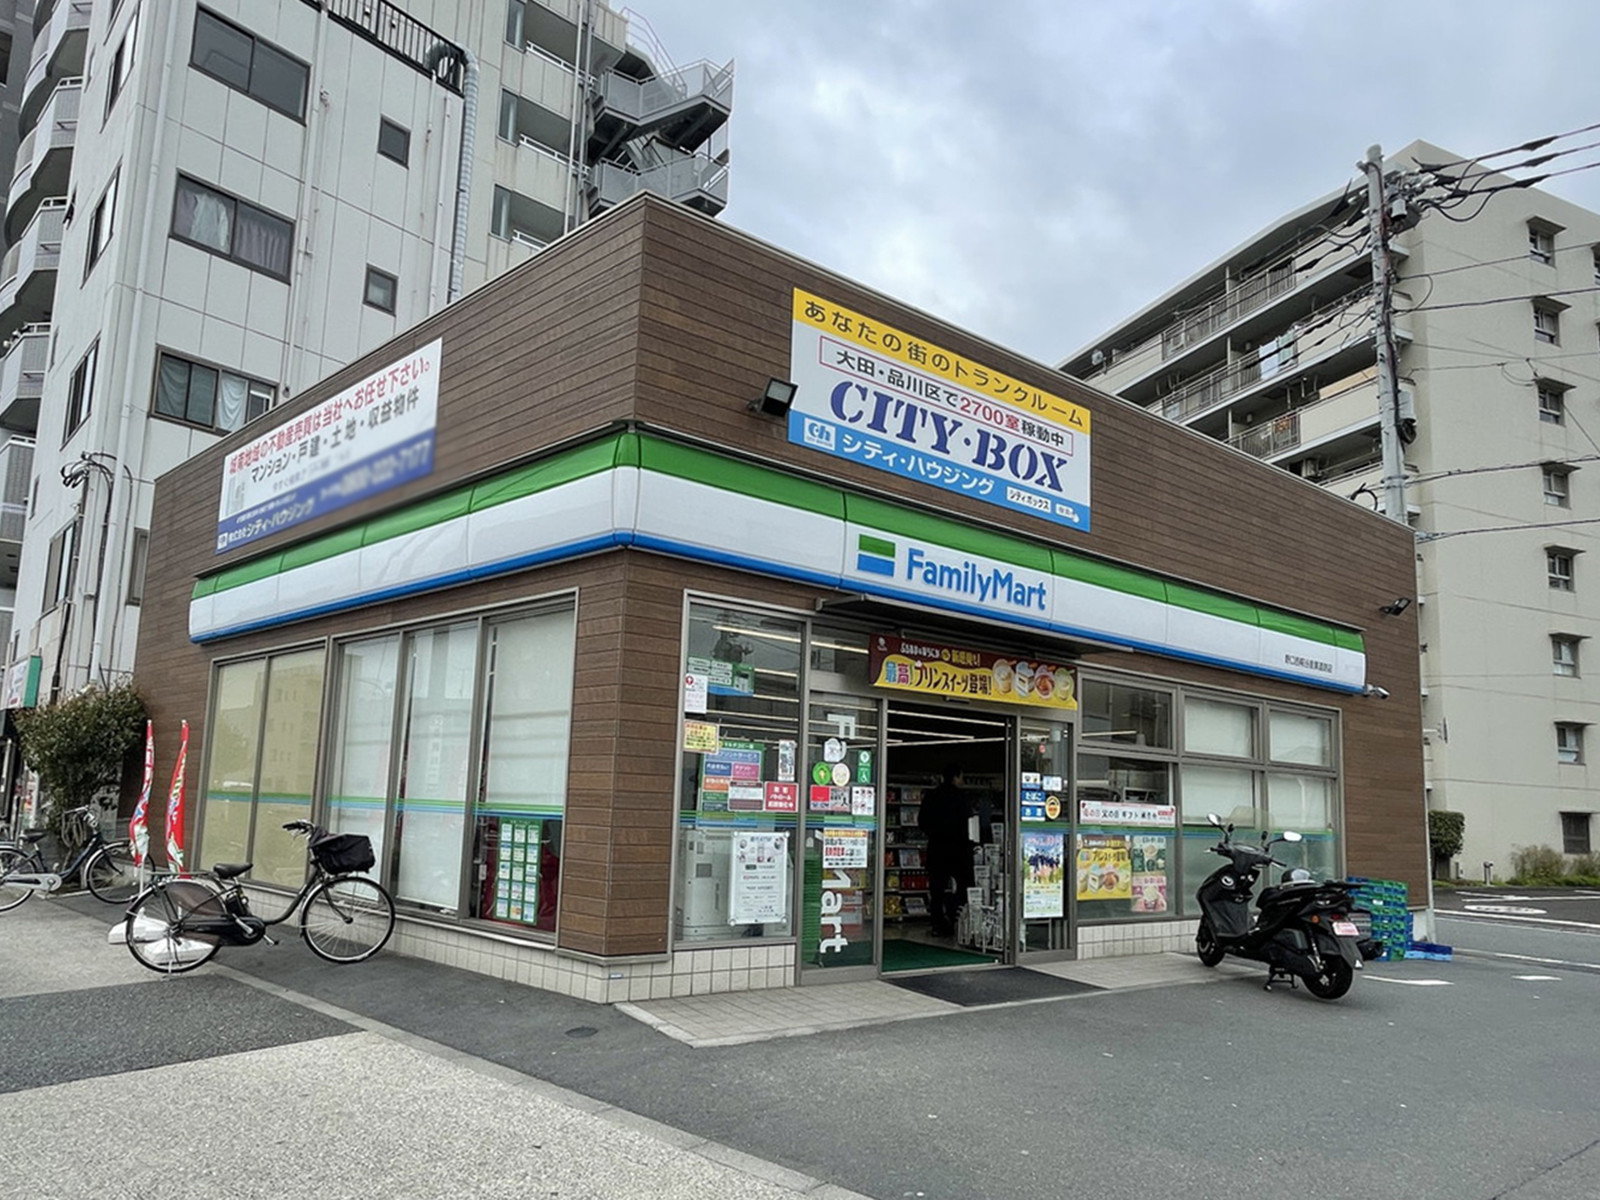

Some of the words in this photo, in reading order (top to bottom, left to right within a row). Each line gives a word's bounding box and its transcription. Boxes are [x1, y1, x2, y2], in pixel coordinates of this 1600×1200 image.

[804, 301, 1083, 427] あなたの街のトランクルーム
[842, 433, 995, 496] シティ・ハウジング
[907, 548, 1047, 610] FamilyMart
